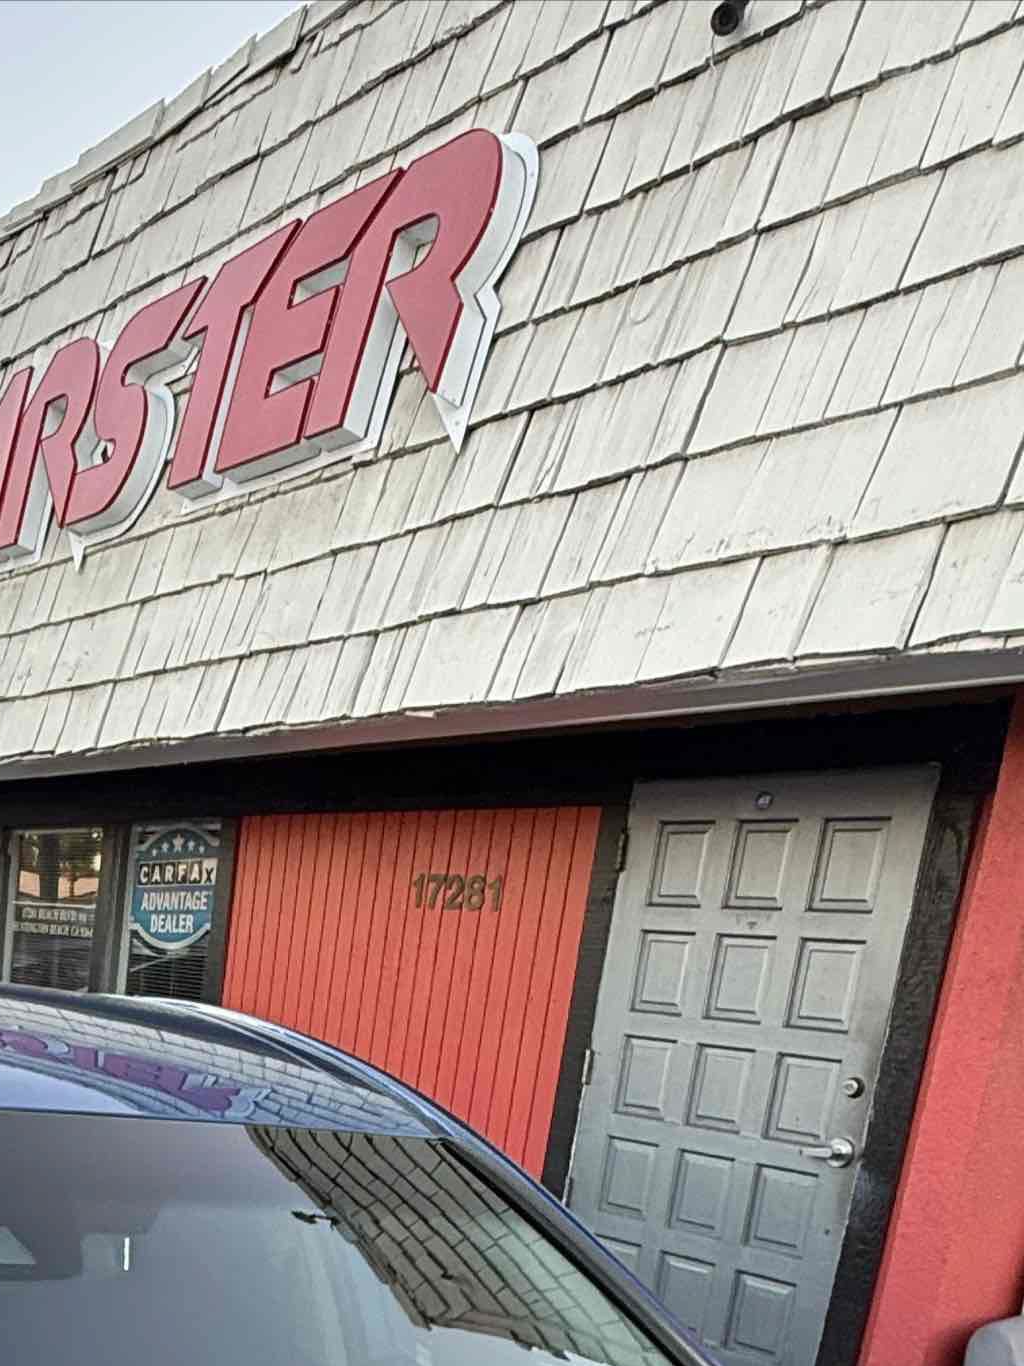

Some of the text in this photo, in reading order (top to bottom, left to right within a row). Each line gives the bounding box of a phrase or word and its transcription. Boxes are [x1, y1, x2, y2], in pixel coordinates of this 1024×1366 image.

[138, 862, 216, 885] CARFAX
[140, 890, 209, 911] ADVANTAGE
[413, 872, 503, 912] 17281
[149, 913, 195, 934] DEALER
